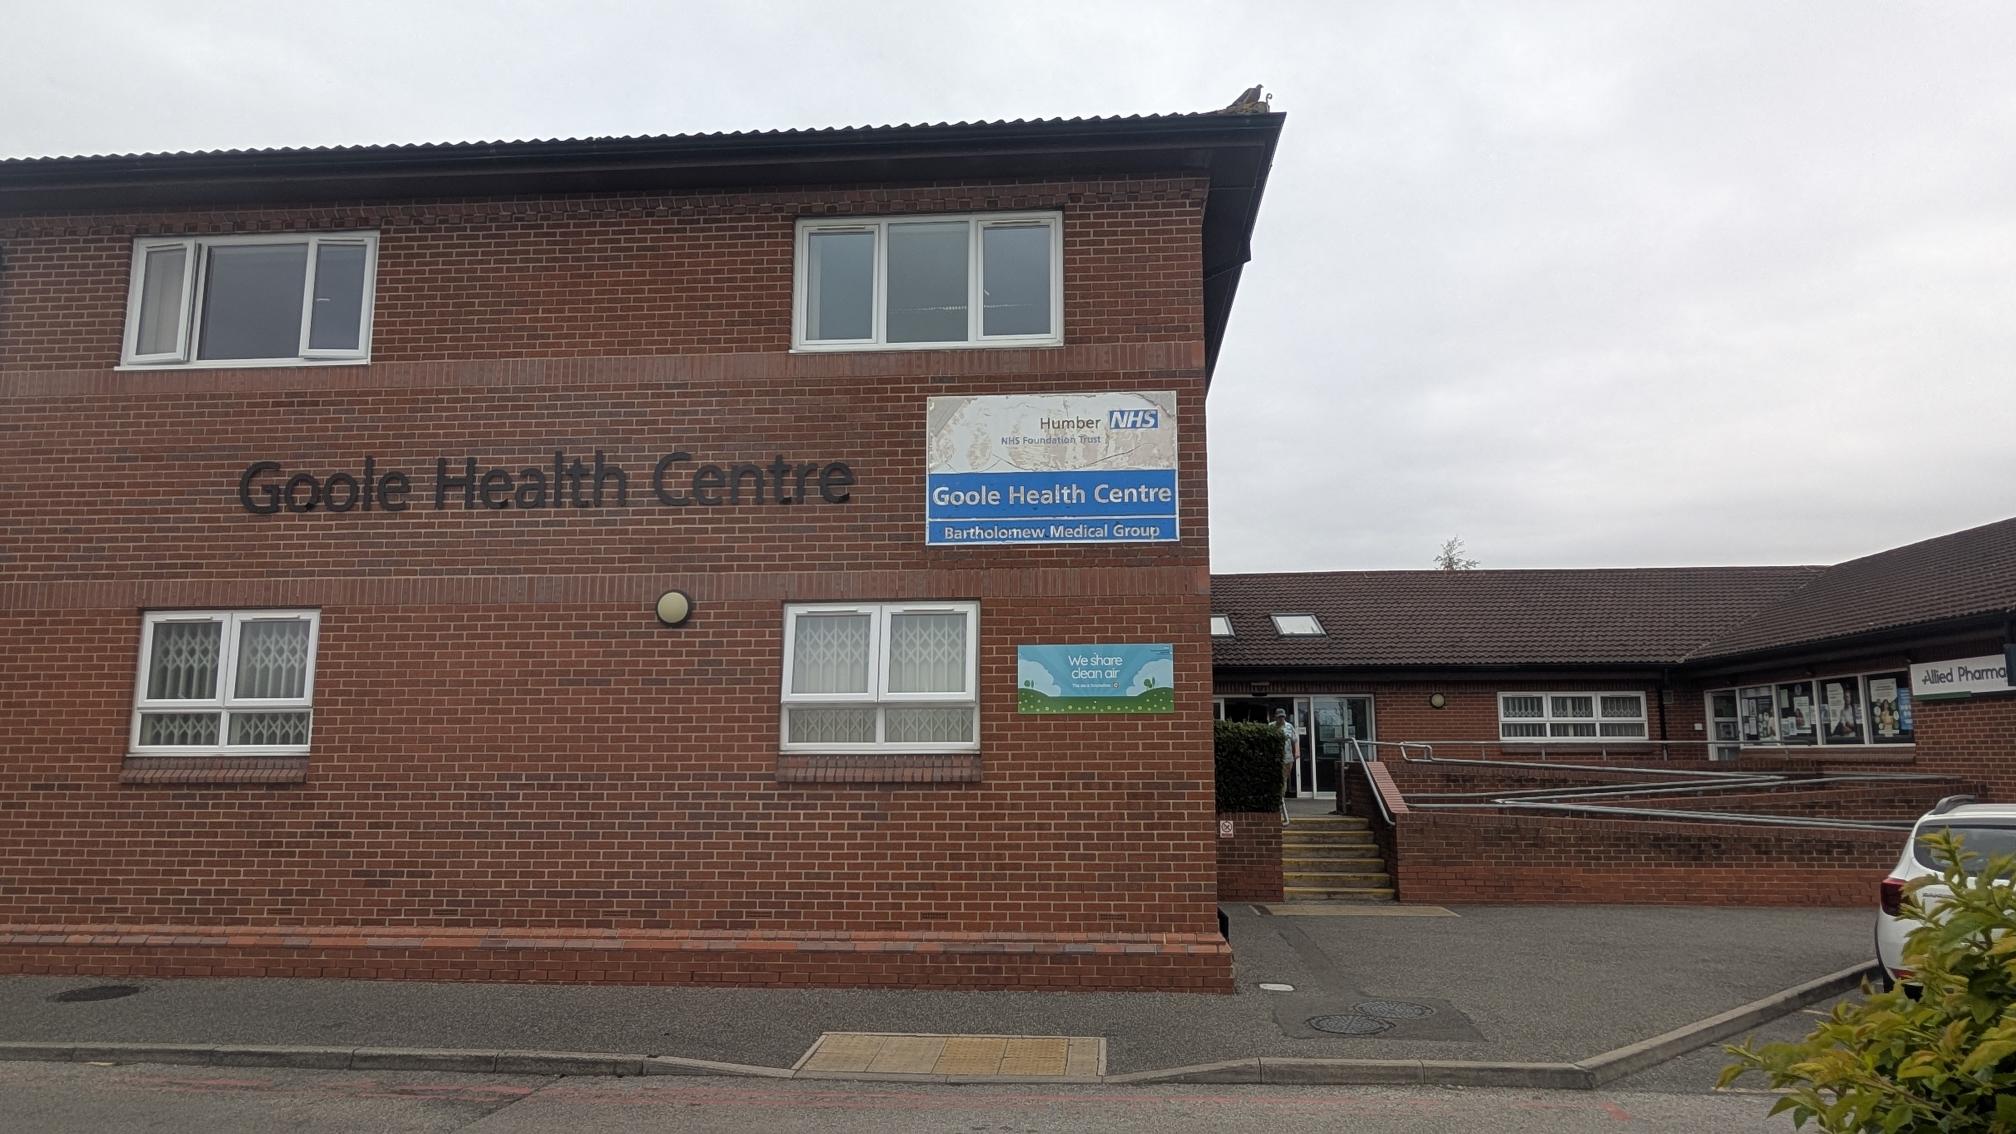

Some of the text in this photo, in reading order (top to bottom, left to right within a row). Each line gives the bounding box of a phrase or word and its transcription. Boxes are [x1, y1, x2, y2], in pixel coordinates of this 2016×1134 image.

[1040, 416, 1101, 430] Humber
[1110, 410, 1156, 429] NHS
[1001, 434, 1101, 445] NHS Foundation Trust
[240, 450, 855, 514] Goole Health Centre
[932, 483, 1172, 506] Goole Health Centre
[944, 523, 1160, 540] Bartholomew Medical Group
[1068, 653, 1123, 667] We share
[1071, 668, 1120, 679] clean air
[1925, 667, 1954, 684] Allied
